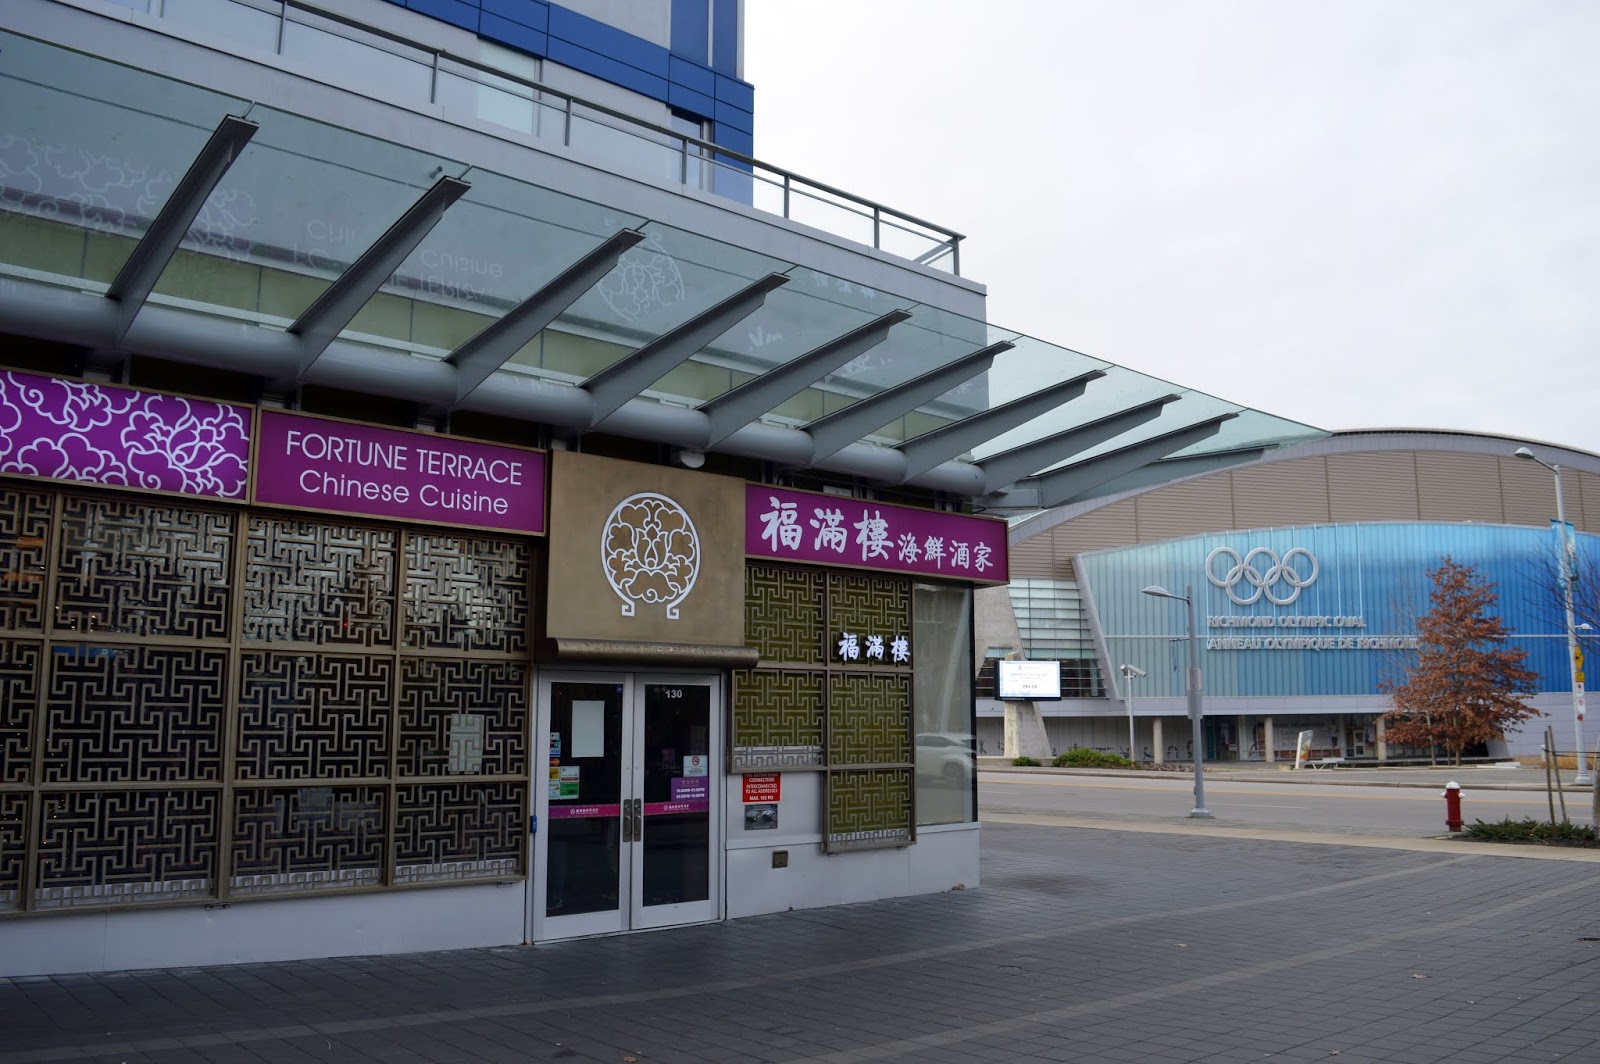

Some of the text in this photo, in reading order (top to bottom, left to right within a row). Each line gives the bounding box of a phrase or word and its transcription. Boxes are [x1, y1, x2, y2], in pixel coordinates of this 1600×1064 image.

[286, 430, 522, 485] FORTUNE TERRACE
[299, 469, 509, 515] Chinese Cuisine
[1207, 615, 1366, 628] RICHMOND OLYMPIC OVAL
[838, 631, 911, 663] 福滿樓
[1208, 637, 1261, 650] ANNEAU
[1264, 637, 1335, 651] OLYMPIQUE
[1338, 637, 1354, 650] DE
[665, 689, 683, 699] 130
